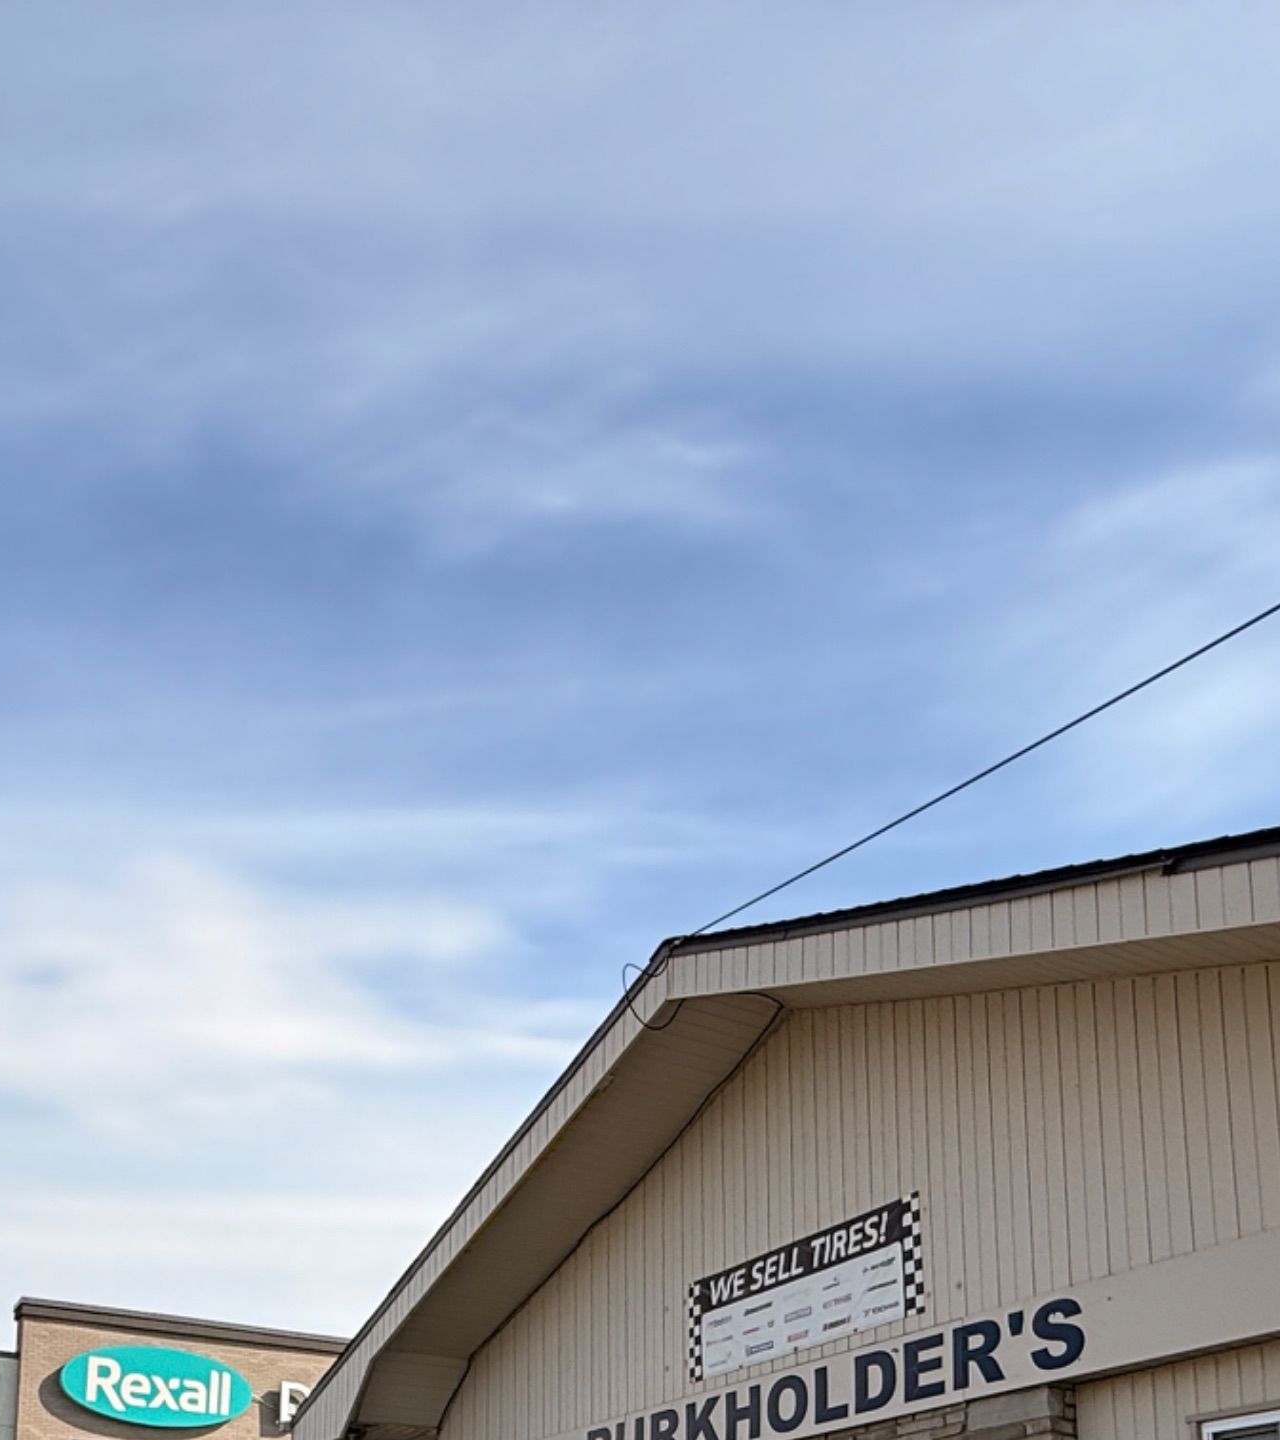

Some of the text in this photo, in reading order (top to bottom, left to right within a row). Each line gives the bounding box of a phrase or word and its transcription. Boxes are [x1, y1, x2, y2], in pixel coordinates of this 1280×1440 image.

[709, 1271, 746, 1306] WE
[750, 1247, 804, 1291] SELL
[811, 1211, 889, 1269] TIRES!
[85, 1356, 231, 1416] Rexall
